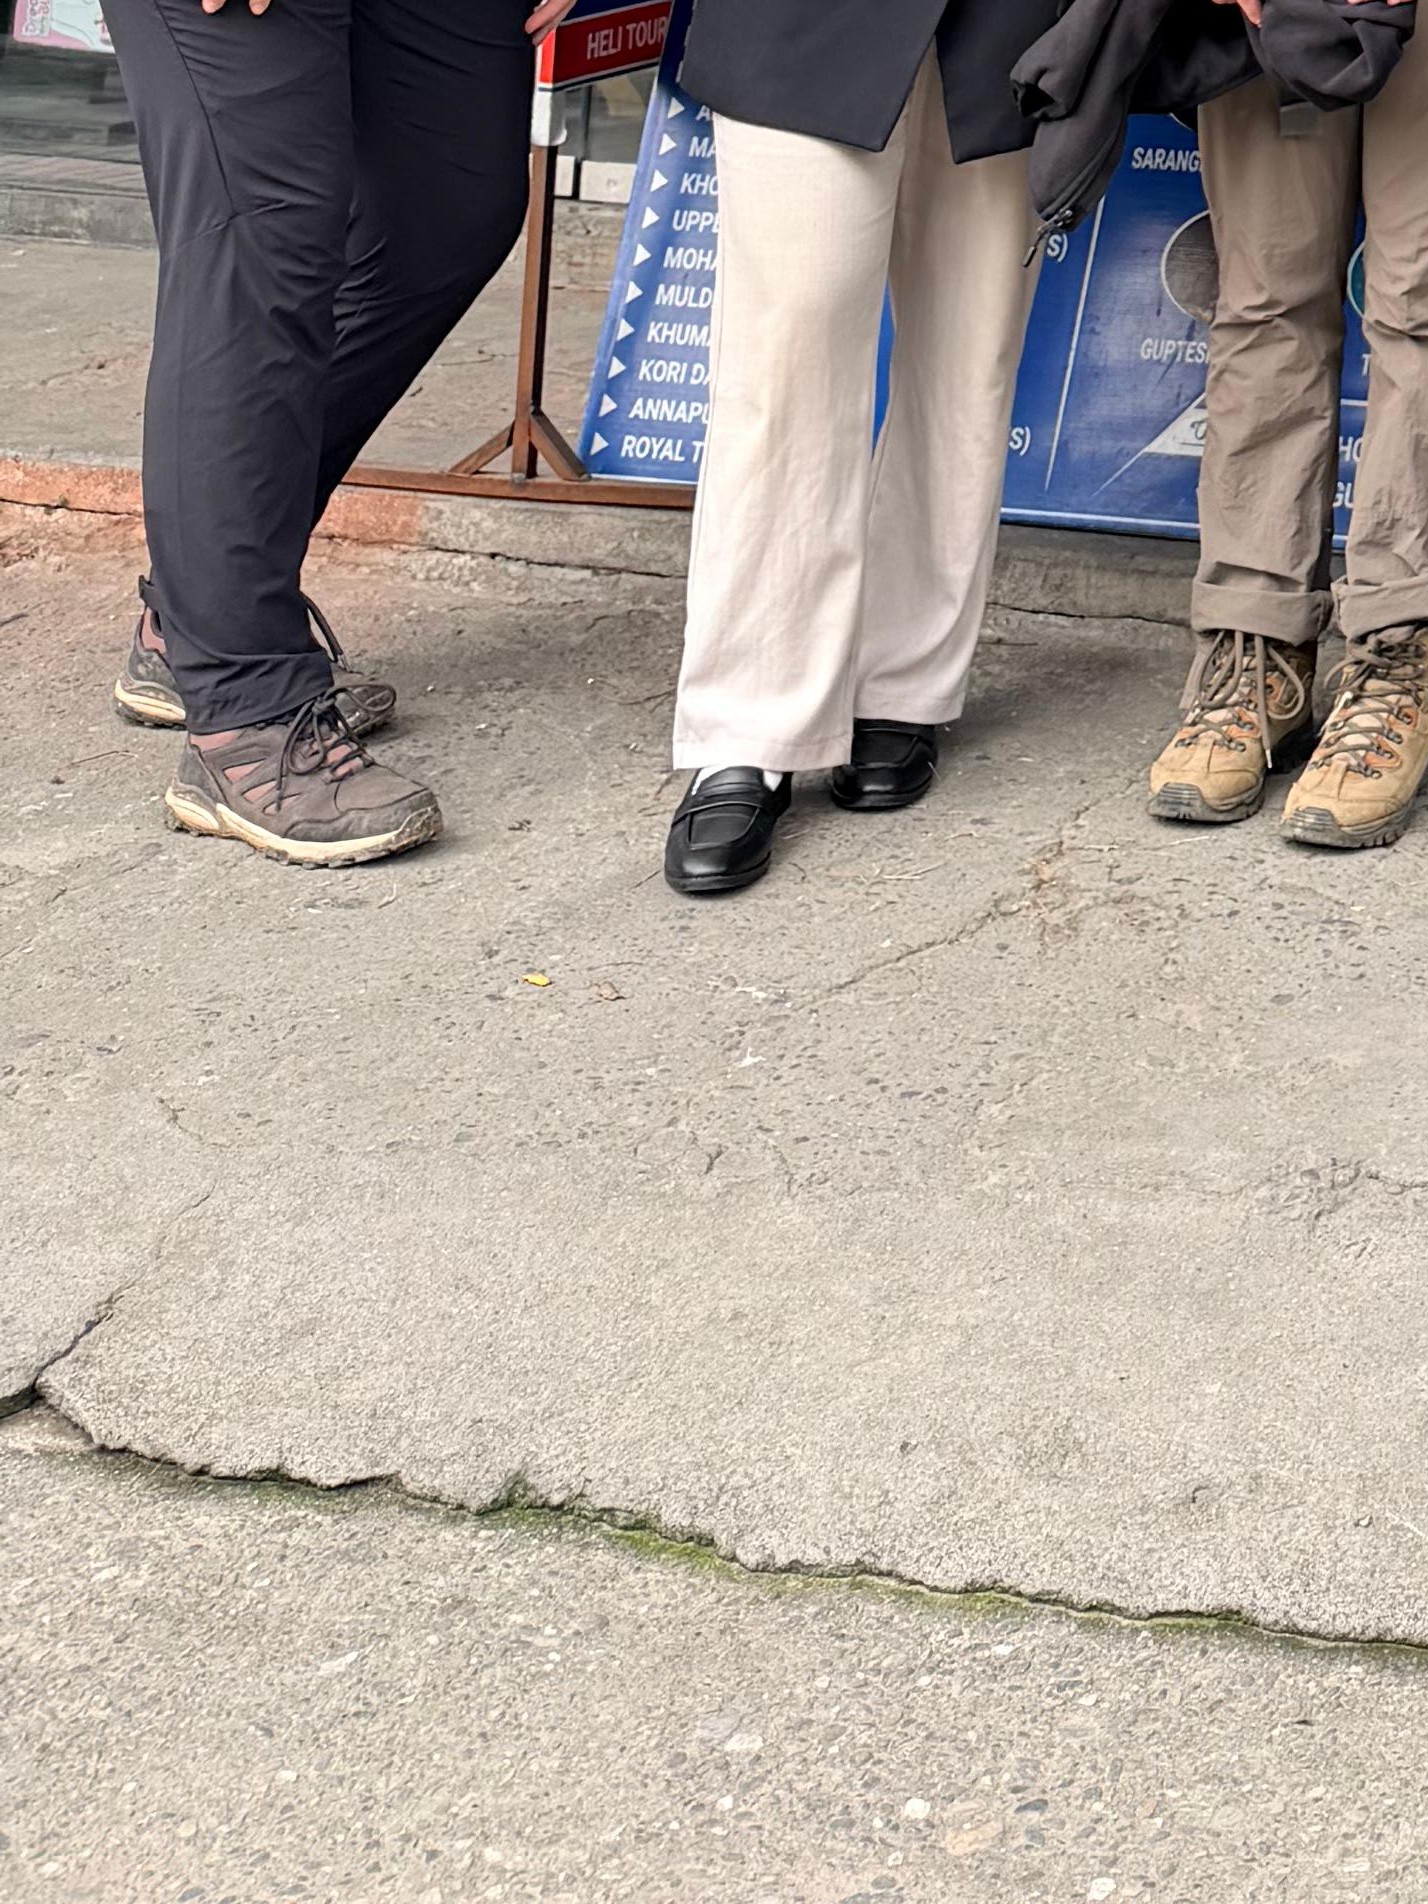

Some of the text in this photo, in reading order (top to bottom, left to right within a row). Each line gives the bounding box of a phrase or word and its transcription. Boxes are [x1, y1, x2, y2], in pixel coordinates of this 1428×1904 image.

[586, 15, 669, 60] HELI TOUR
[1132, 148, 1200, 171] SARANG
[672, 209, 721, 232] UPPE
[655, 284, 713, 308] MULD
[647, 321, 710, 347] KHUM
[1140, 337, 1209, 364] GUPTES
[638, 359, 686, 383] KORI
[629, 396, 709, 425] ANNAPU
[621, 435, 685, 462] ROYAL
